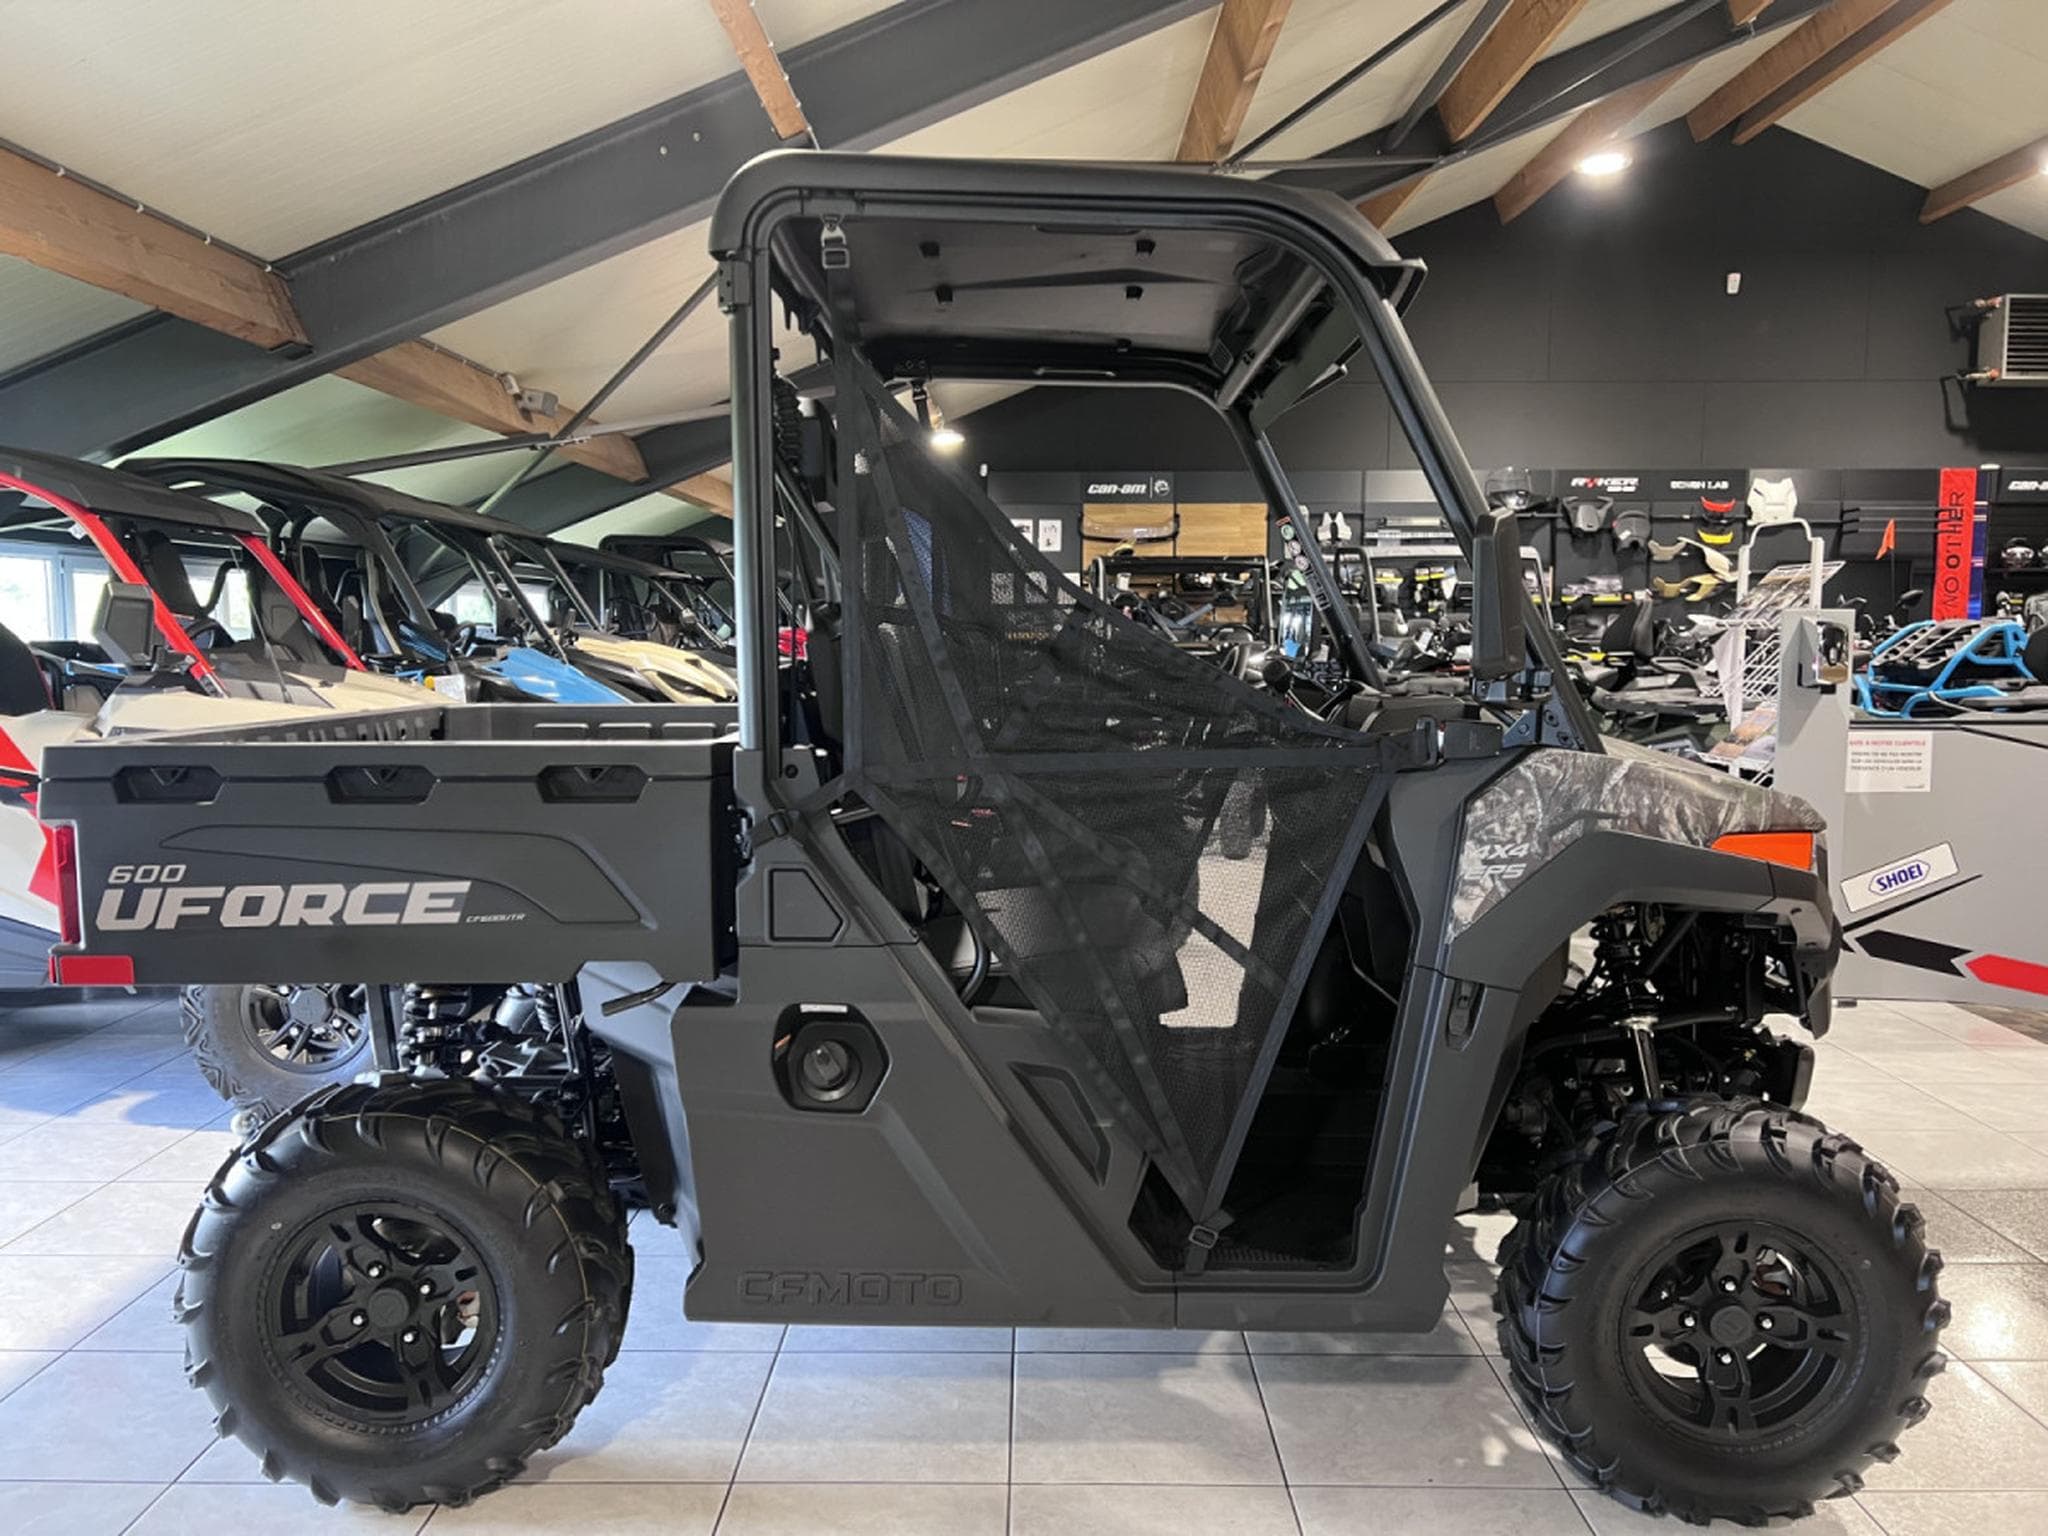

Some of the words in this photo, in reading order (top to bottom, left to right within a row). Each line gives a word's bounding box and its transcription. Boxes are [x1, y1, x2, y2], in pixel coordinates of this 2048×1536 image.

[108, 864, 187, 884] 600
[1463, 863, 1527, 880] EPS
[1875, 862, 1924, 891] SHOEI
[96, 880, 472, 931] UFORCE
[737, 1270, 963, 1306] CFMOTO
